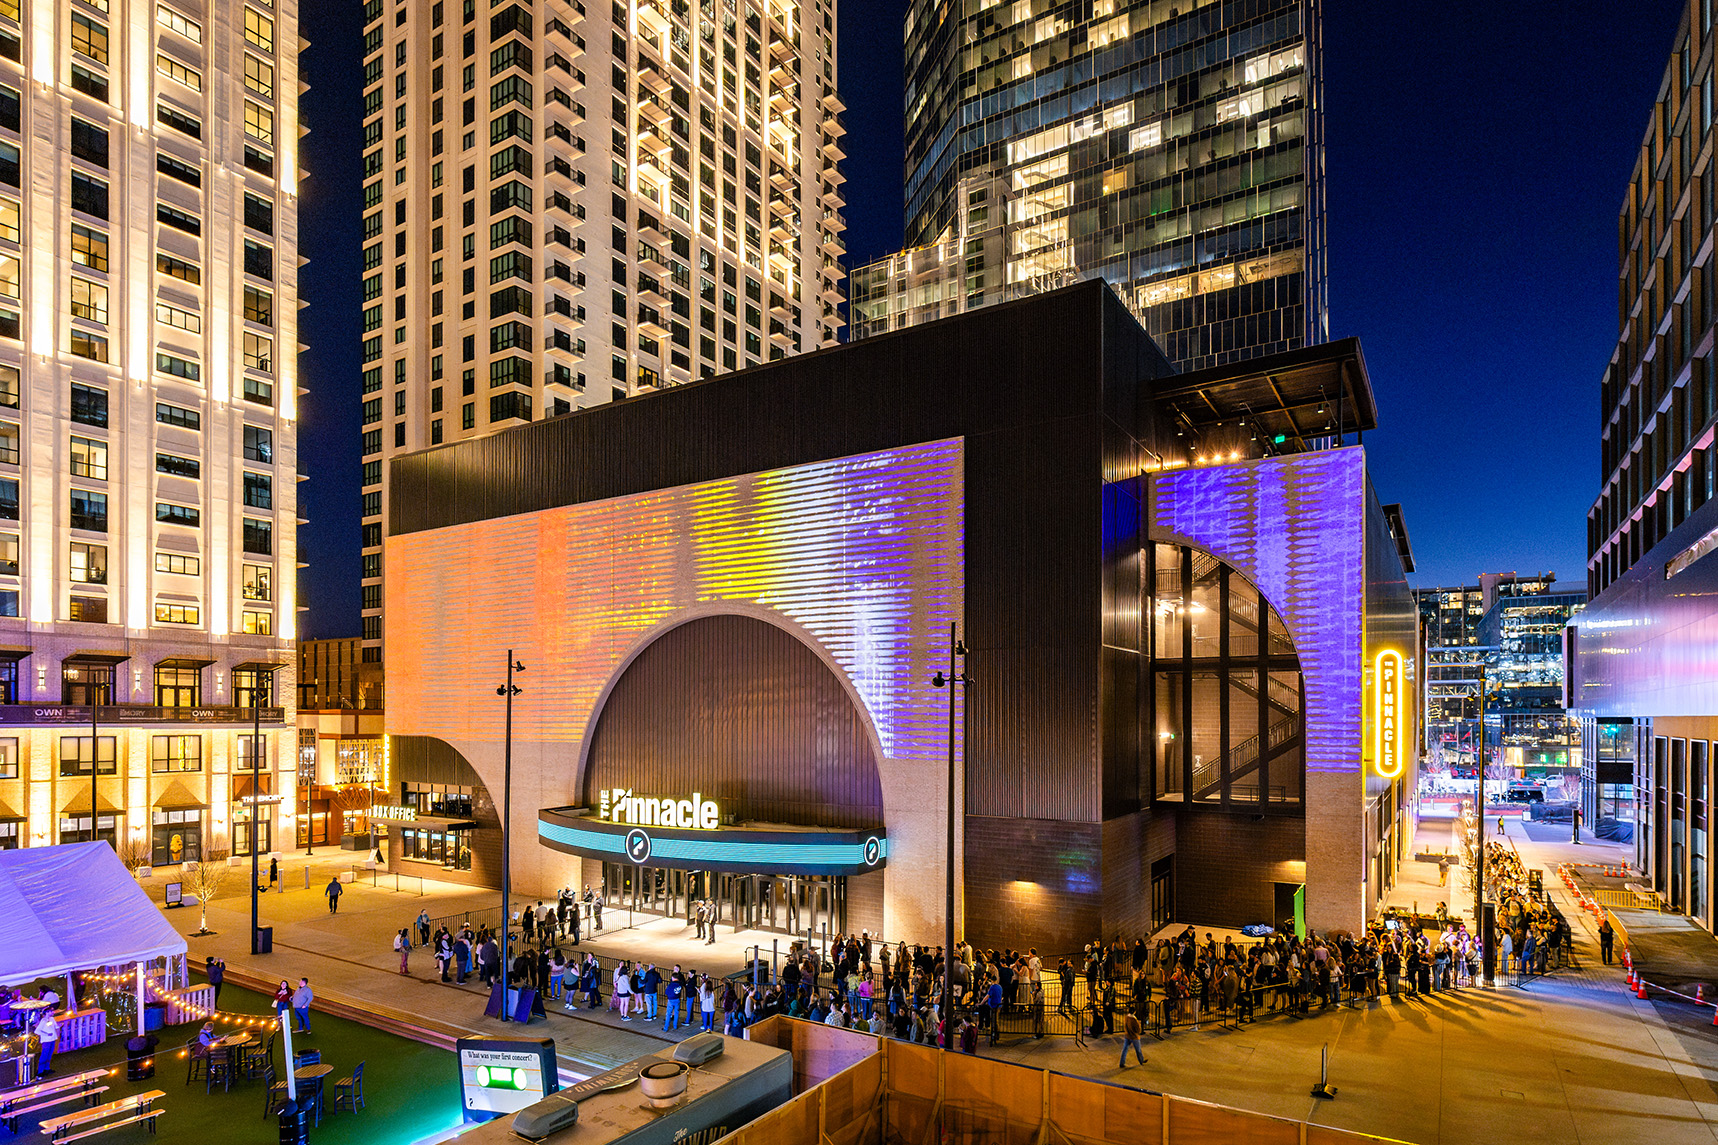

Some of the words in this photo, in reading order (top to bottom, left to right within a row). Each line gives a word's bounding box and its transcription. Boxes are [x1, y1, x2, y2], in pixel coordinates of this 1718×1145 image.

[34, 708, 62, 716] OWN
[1383, 668, 1394, 766] PINNACLE
[373, 805, 388, 818] BOX
[389, 806, 416, 821] OFFICE
[600, 789, 610, 819] THE
[612, 788, 719, 829] Pinnacle
[467, 1051, 479, 1059] What
[512, 1054, 533, 1062] concert?
